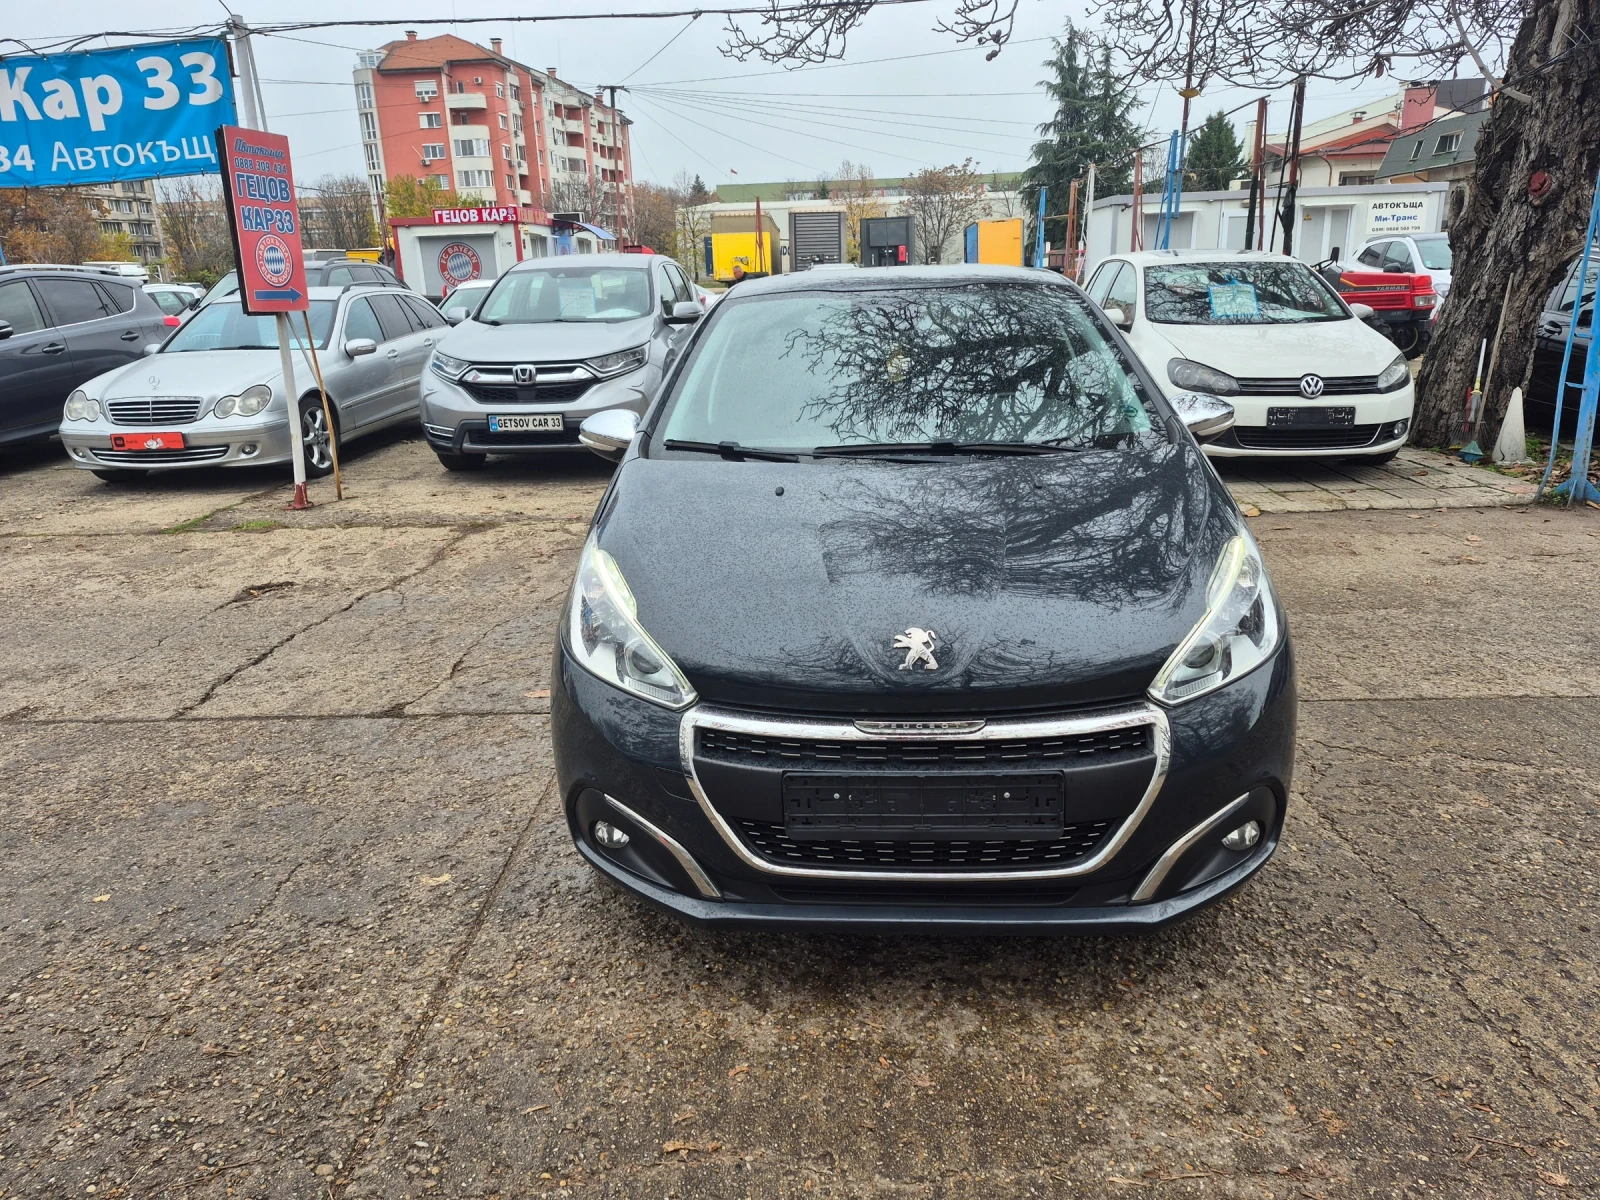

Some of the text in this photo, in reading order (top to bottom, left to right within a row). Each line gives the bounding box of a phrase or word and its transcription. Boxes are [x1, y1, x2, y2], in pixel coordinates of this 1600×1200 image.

[0, 52, 224, 132] Кар 33
[51, 135, 217, 172] Автокъщ
[234, 157, 287, 174] 0888 309 434
[235, 172, 291, 204] ГЕЦОВ
[1371, 201, 1424, 210] АВТОКЪЩА
[240, 205, 295, 234] КАР33
[434, 208, 479, 223] ГЕЦОВ
[482, 208, 508, 222] КАР
[1374, 214, 1418, 222] Ми-Транс
[258, 237, 289, 258] АВТОКЪЩА
[441, 245, 478, 264] FC BAYERN
[497, 418, 530, 428] GETSOV
[532, 418, 549, 428] CAR
[551, 417, 561, 428] 33
